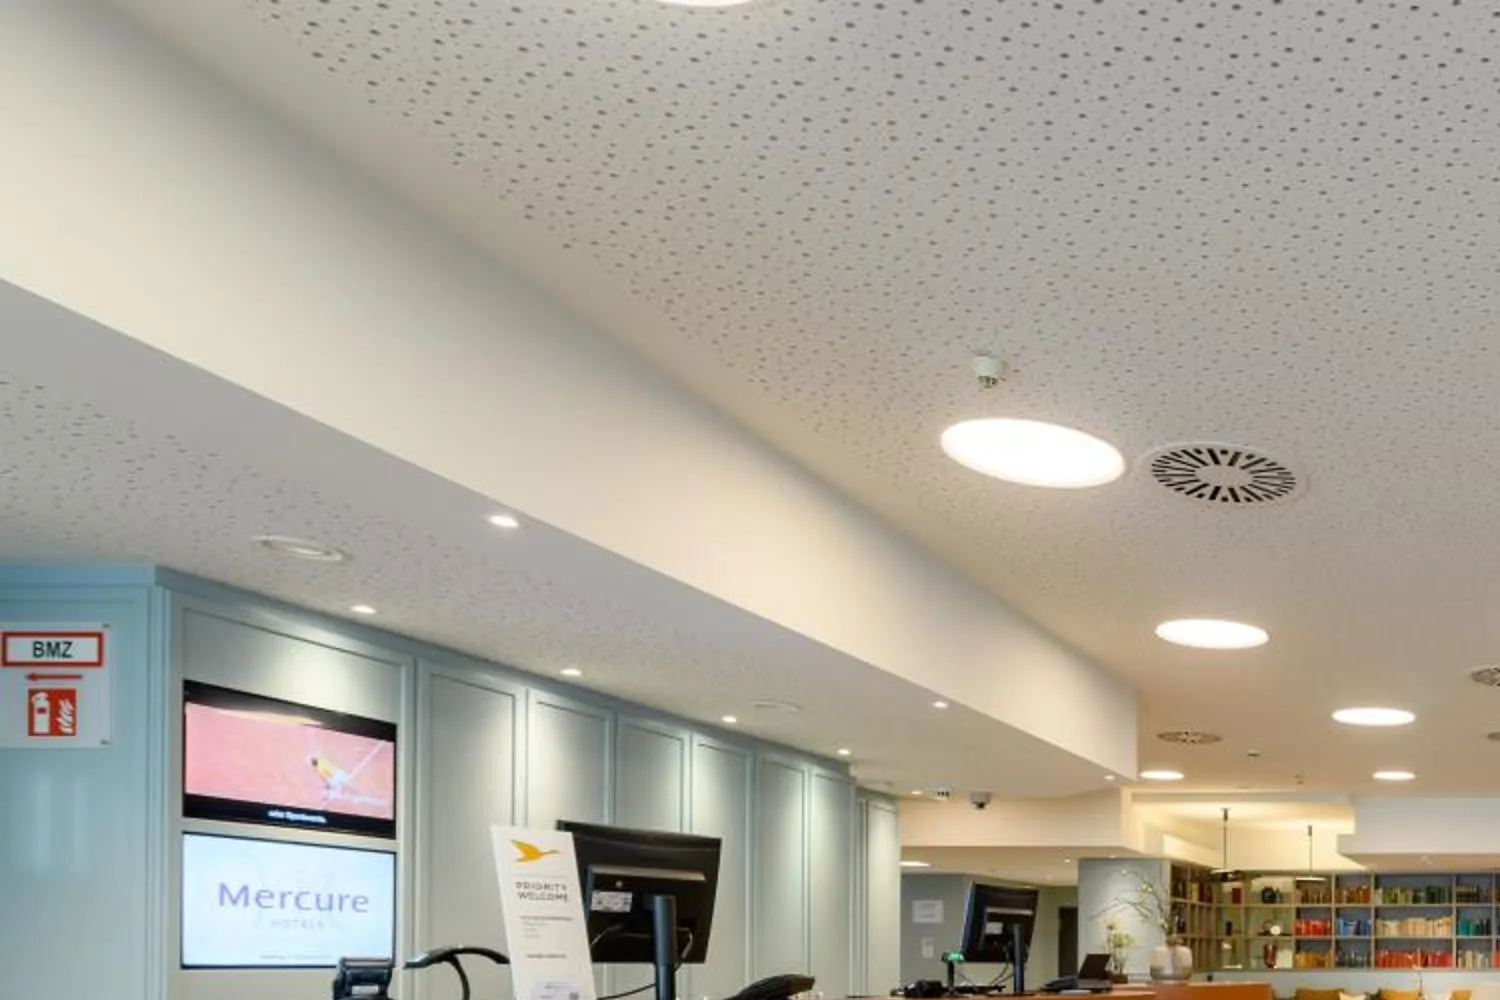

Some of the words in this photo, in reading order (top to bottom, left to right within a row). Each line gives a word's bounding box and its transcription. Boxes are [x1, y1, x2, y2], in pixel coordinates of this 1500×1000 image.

[32, 640, 74, 659] BMZ
[515, 881, 567, 891] PRIORITY
[217, 882, 370, 913] Mercure
[518, 892, 568, 901] WELCOME
[269, 918, 326, 930] HOTELS
